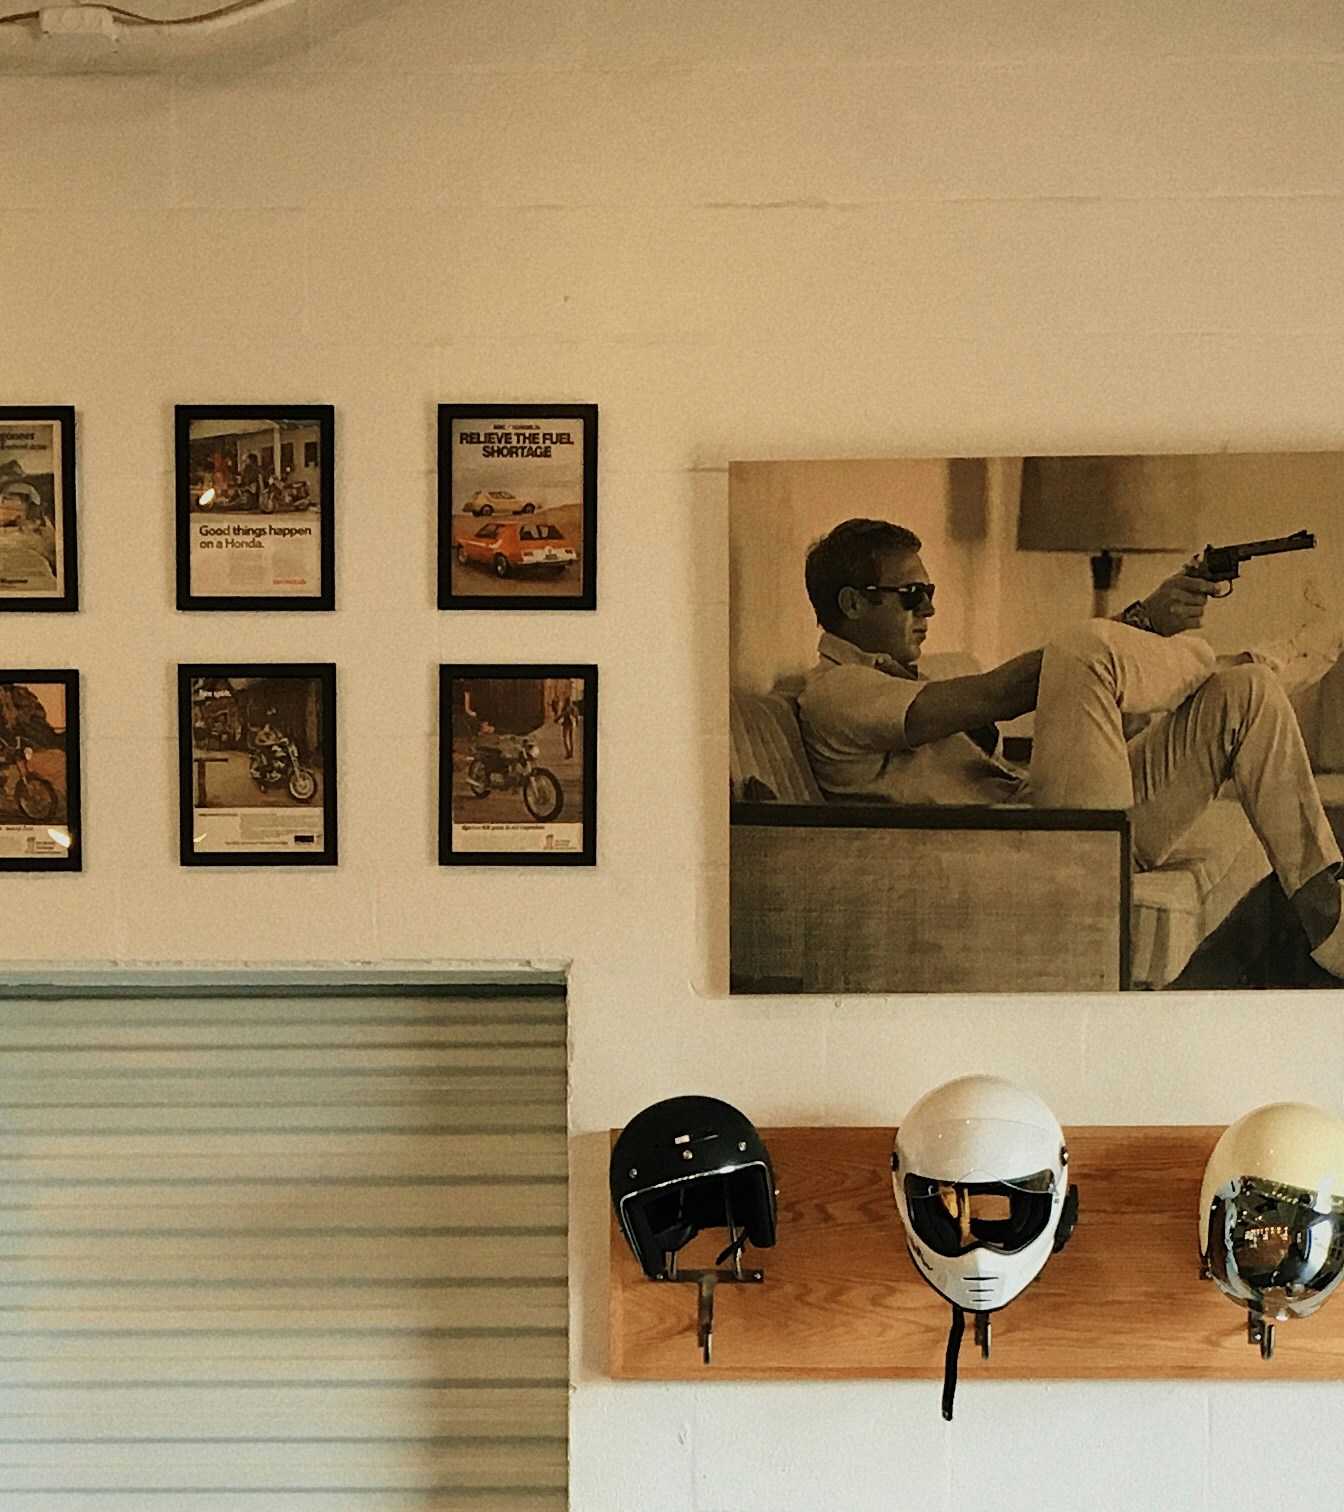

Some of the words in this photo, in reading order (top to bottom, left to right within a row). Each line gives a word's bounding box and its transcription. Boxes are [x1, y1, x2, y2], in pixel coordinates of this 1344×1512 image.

[459, 432, 512, 444] RELIEVE
[513, 432, 540, 444] THE
[542, 432, 575, 444] FUEL
[482, 445, 552, 458] SHORTAGE
[199, 524, 231, 536] Good
[232, 524, 267, 538] things
[269, 524, 312, 538] happen
[199, 540, 214, 549] on
[216, 540, 223, 549] a
[225, 538, 265, 549] Honda.
